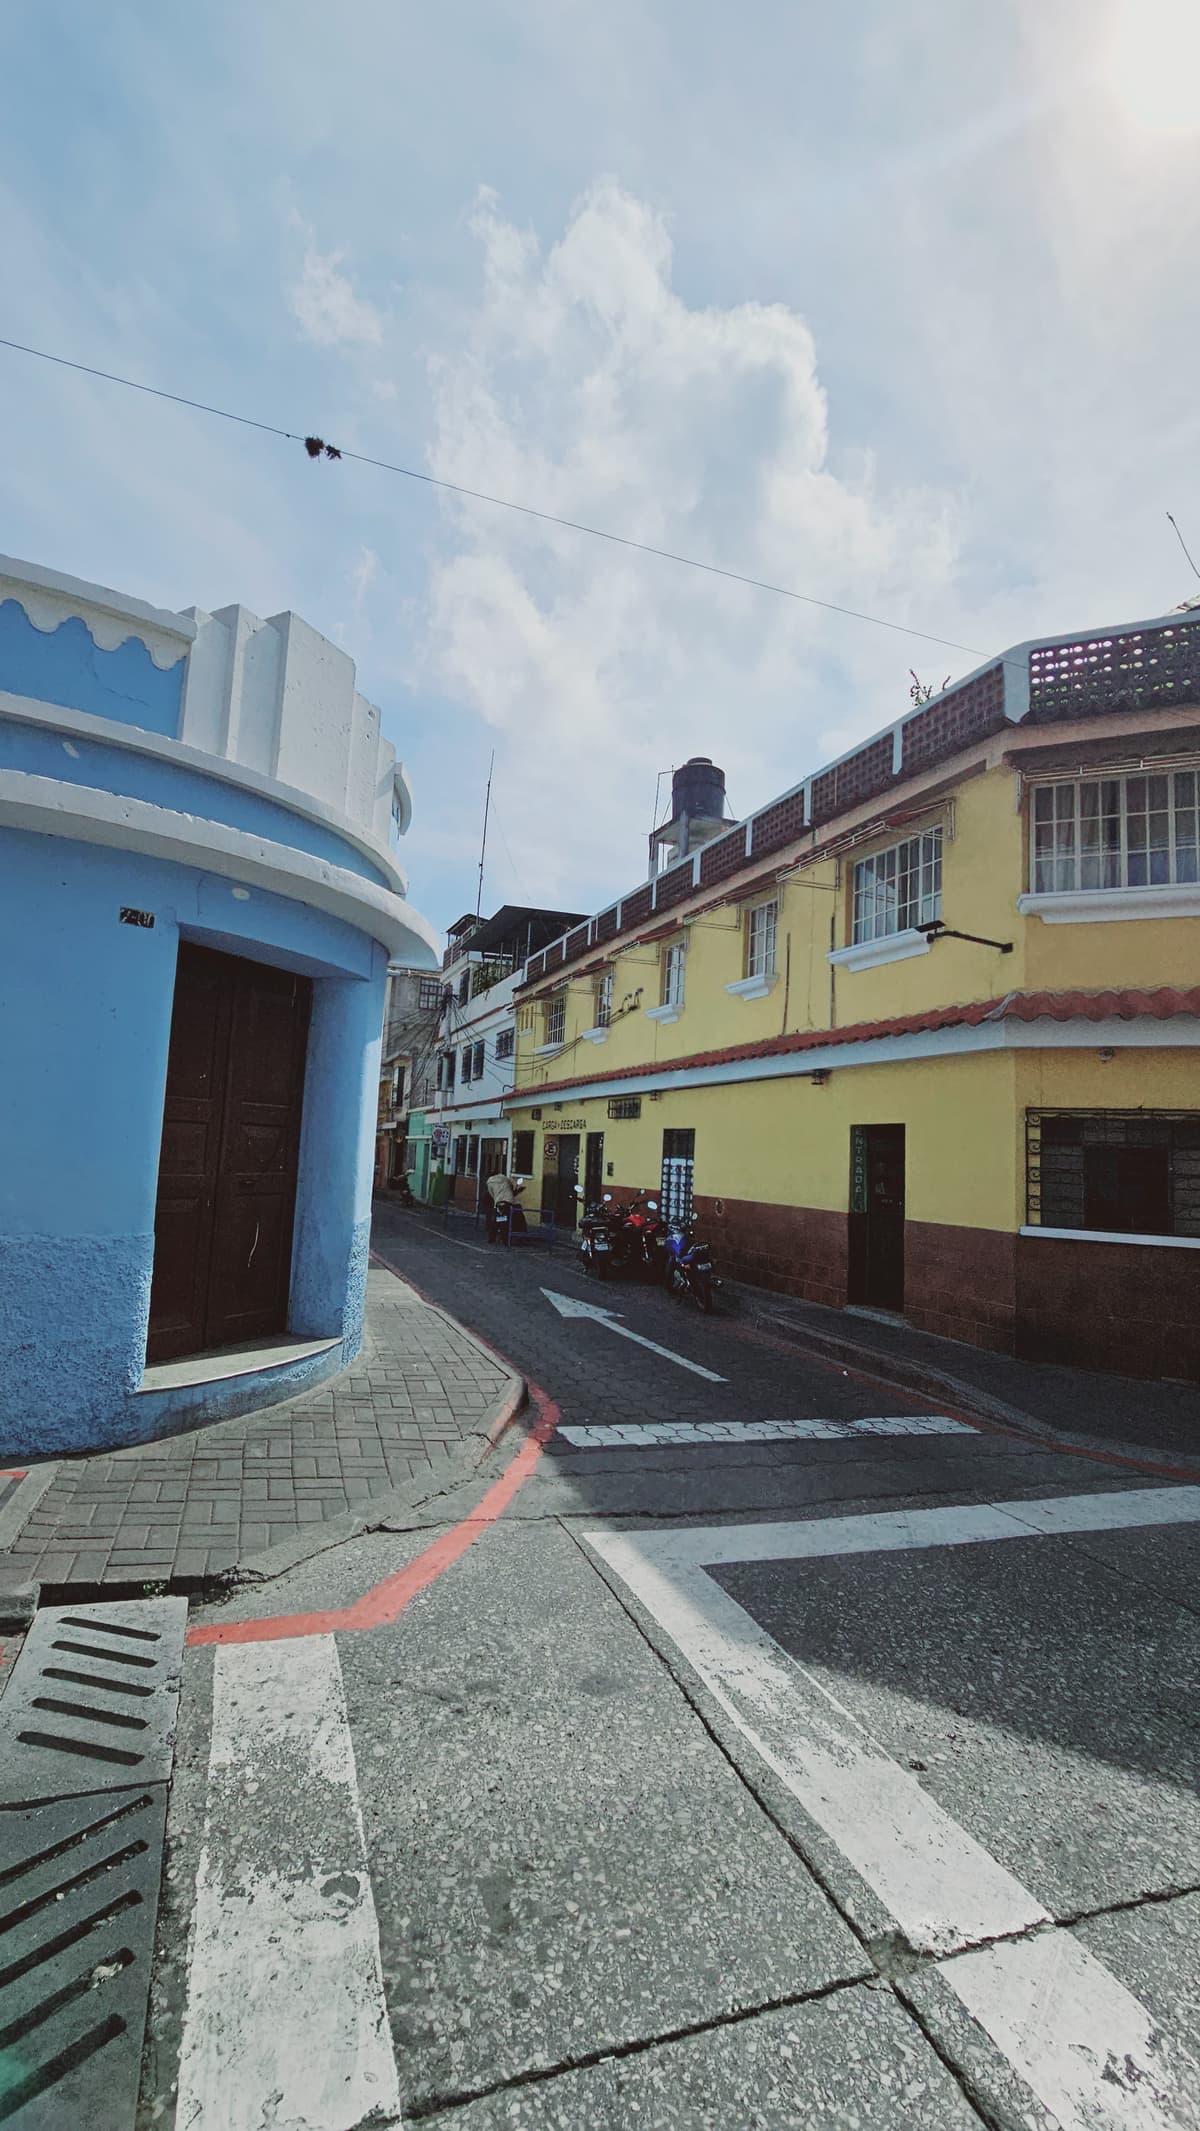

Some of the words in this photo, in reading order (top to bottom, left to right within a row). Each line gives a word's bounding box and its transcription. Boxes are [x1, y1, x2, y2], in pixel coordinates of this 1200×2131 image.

[542, 1120, 557, 1130] CARGA
[560, 1119, 587, 1129] DESCARGA
[855, 1127, 864, 1193] ENTRADA
